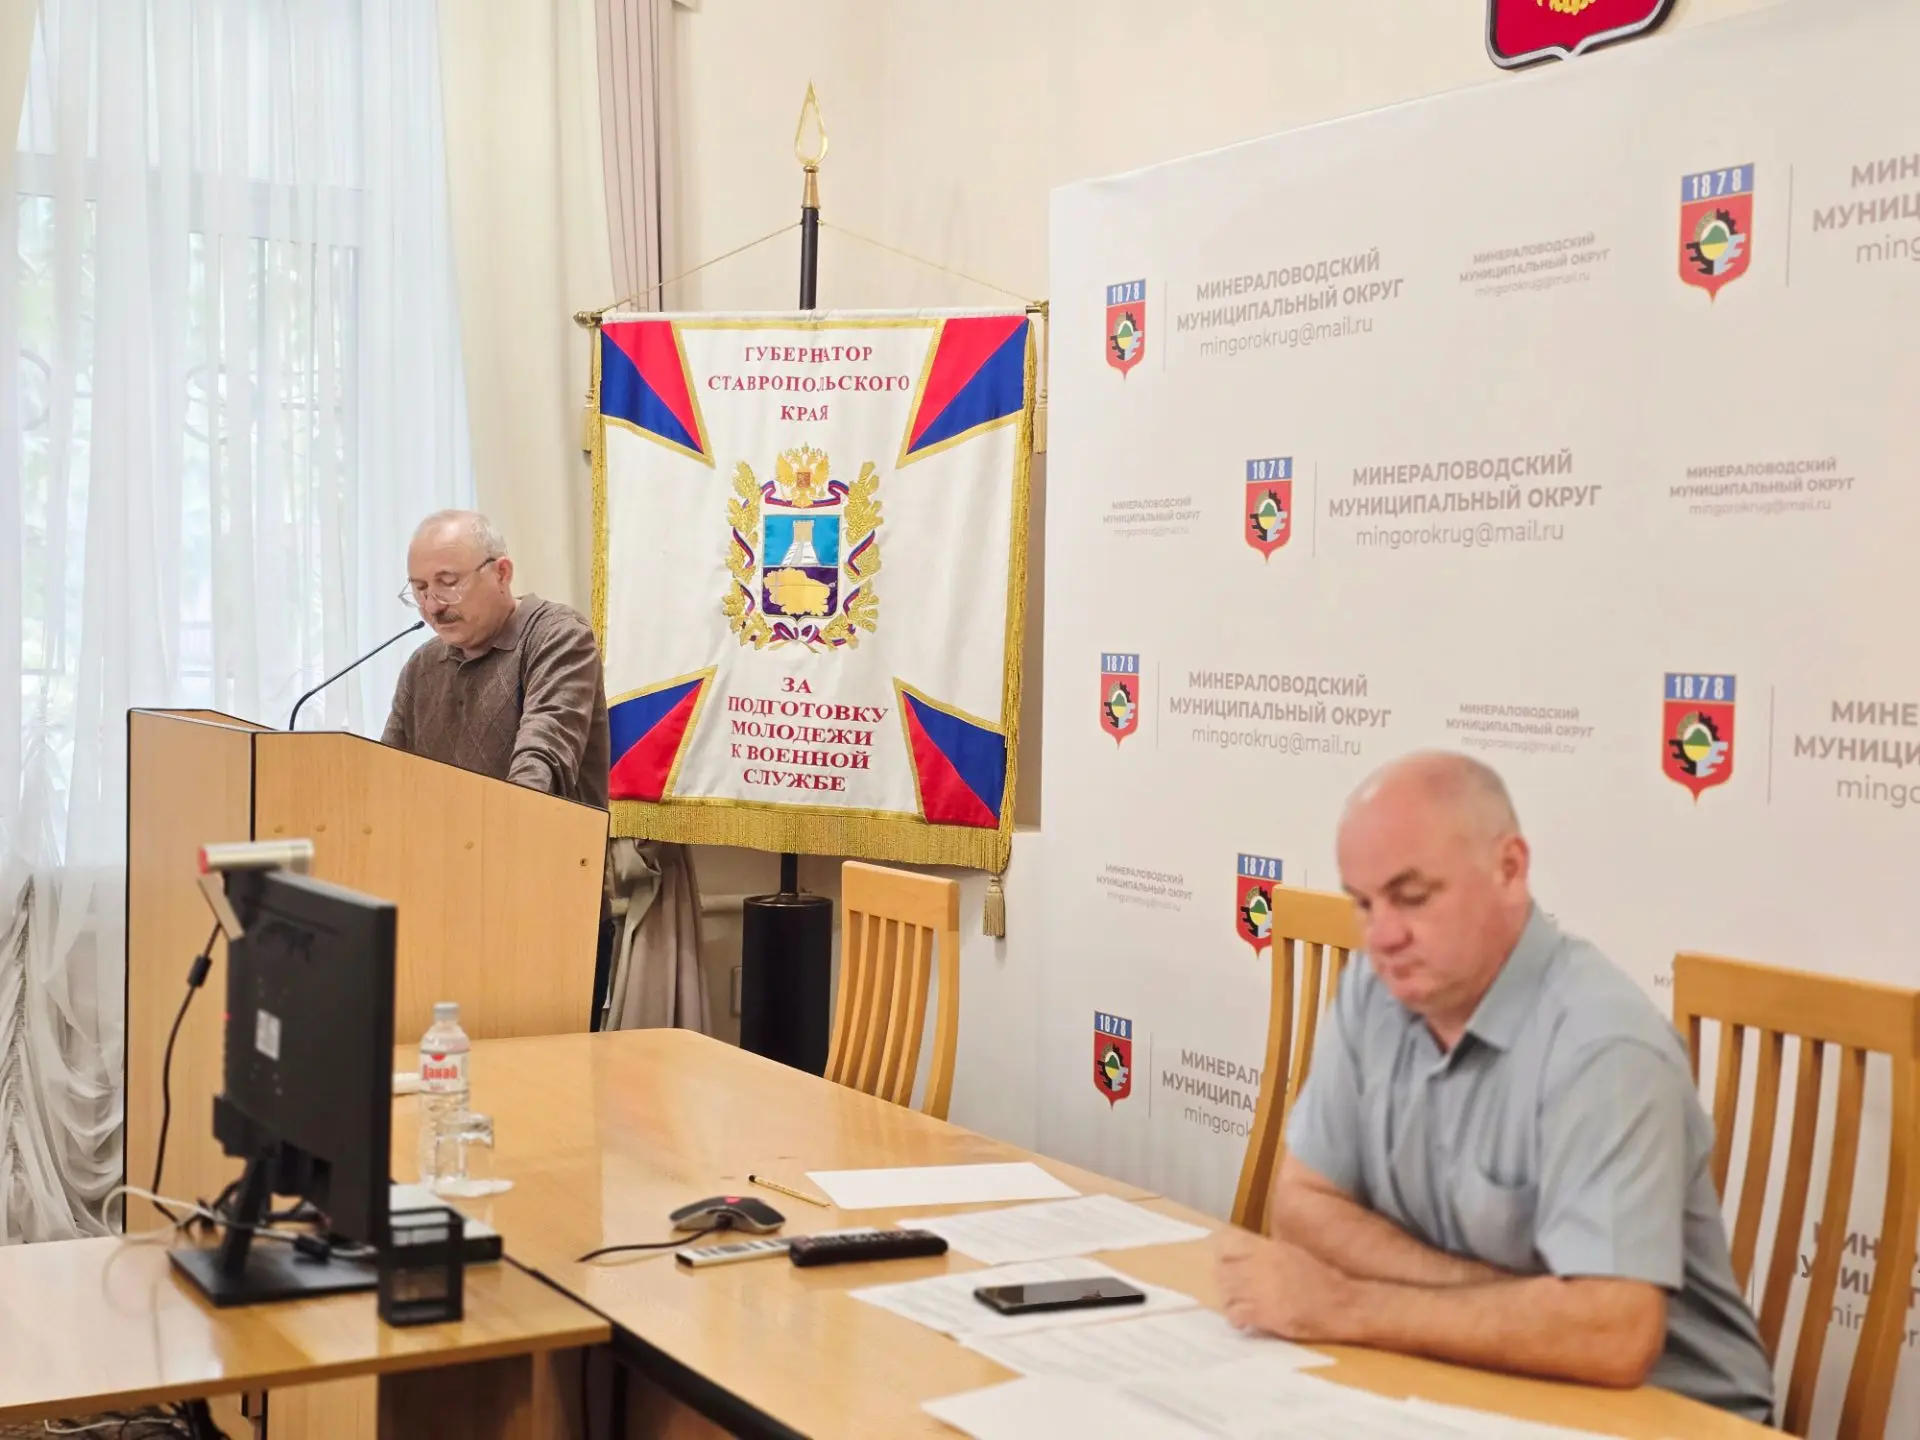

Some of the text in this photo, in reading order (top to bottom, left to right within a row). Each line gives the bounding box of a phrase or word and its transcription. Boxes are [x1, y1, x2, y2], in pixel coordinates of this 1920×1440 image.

[1692, 168, 1743, 200] 1878
[1852, 154, 1920, 188] МИН
[1473, 231, 1595, 265] МИНЕРАЛОВОДСКИЙ
[1197, 247, 1380, 301] МИНЕРАЛОВОДСКИЙ
[1460, 249, 1611, 282] МУНИЦИПАЛЬНЫЙ ОКРУГ
[1111, 284, 1140, 304] 1878
[1177, 278, 1404, 332] МУНИЦИПАЛЬНЫЙ ОКРУГ
[1200, 316, 1373, 357] mingorokrug@mail.ru
[745, 346, 873, 363] ГУБЕРНАТОР
[708, 376, 910, 393] СТАВРОПОЛЬСКОГО
[781, 405, 829, 421] КРАЯ
[1252, 460, 1285, 480] 1878
[1353, 449, 1573, 487] МИНЕРАЛОВОДСКИЙ
[1686, 457, 1837, 479] МИНЕРАЛОВОДСКИЙ
[1670, 477, 1855, 498] МУНИЦИПАЛЬНЫЙ ОКРУГ
[1329, 485, 1603, 518] МУНИЦИПАЛЬНЫЙ ОКРУГ
[1356, 521, 1564, 549] mingorokrug@mail.ru
[1106, 655, 1134, 673] 1878
[781, 677, 812, 694] ЗА
[1189, 671, 1368, 698] МИНЕРАЛОВОДСКИЙ
[1674, 676, 1725, 700] 1878
[727, 696, 889, 723] ПОДГОТОВКУ
[1169, 696, 1392, 728] МУНИЦИПАЛЬНЫЙ ОКРУГ
[1460, 703, 1580, 722] МИНЕРАЛОВОДСКИЙ
[1831, 700, 1918, 727] МИНЕ
[731, 720, 873, 746] МОЛОДЕЖИ
[1192, 726, 1361, 756] mingorokrug@mail.ru
[1446, 718, 1596, 738] МУНИЦИПАЛЬНЫЙ ОКРУГ
[731, 743, 870, 770] К ВОЕННОЙ
[1794, 734, 1920, 768] МУНИЦИ
[743, 768, 846, 791] СЛУЖБЕ
[1244, 856, 1276, 878] 1878
[1099, 1014, 1126, 1037] 1878
[1181, 1049, 1259, 1086] МИНЕРАЛ
